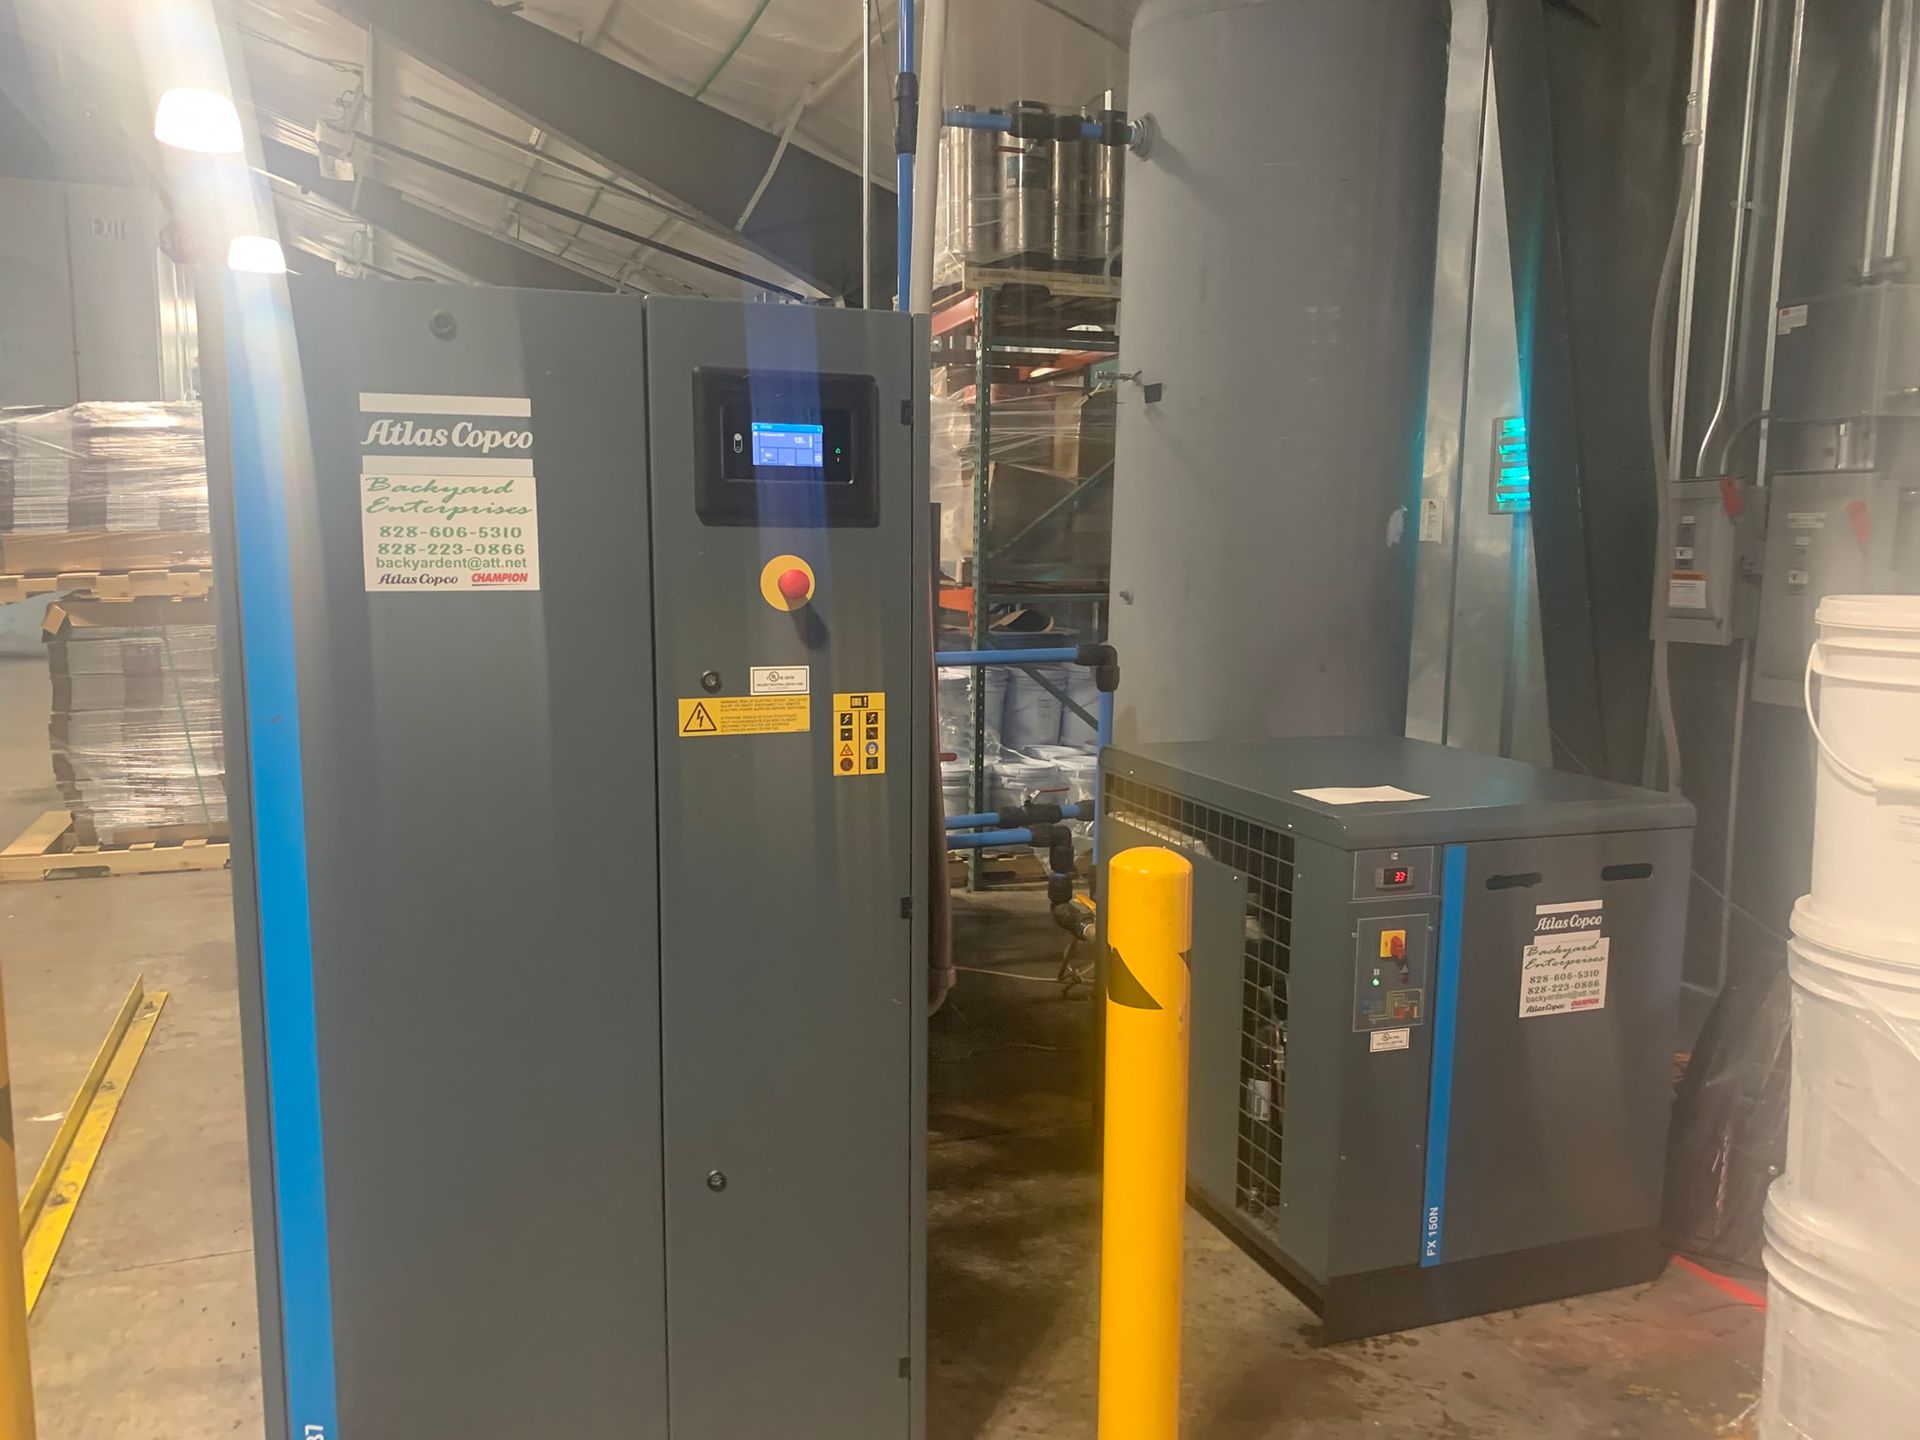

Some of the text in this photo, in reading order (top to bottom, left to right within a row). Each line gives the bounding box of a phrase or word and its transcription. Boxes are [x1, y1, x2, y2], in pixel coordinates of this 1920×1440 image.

[361, 419, 533, 453] Atlas Copco
[365, 476, 515, 503] Backyard
[366, 497, 532, 521] Enterprises
[379, 526, 522, 538] 828-606-5310
[377, 543, 525, 555] 828-223-0866
[376, 557, 527, 571] backyardent@att.net
[377, 572, 528, 586] Atlas Copco CHAMPION
[1534, 914, 1602, 931] Atlas Copco
[1526, 940, 1600, 959] Backyard
[1529, 969, 1600, 984] 828-606-5310
[1527, 980, 1600, 995] 828-223-0866
[1427, 1207, 1439, 1257] FX 150N
